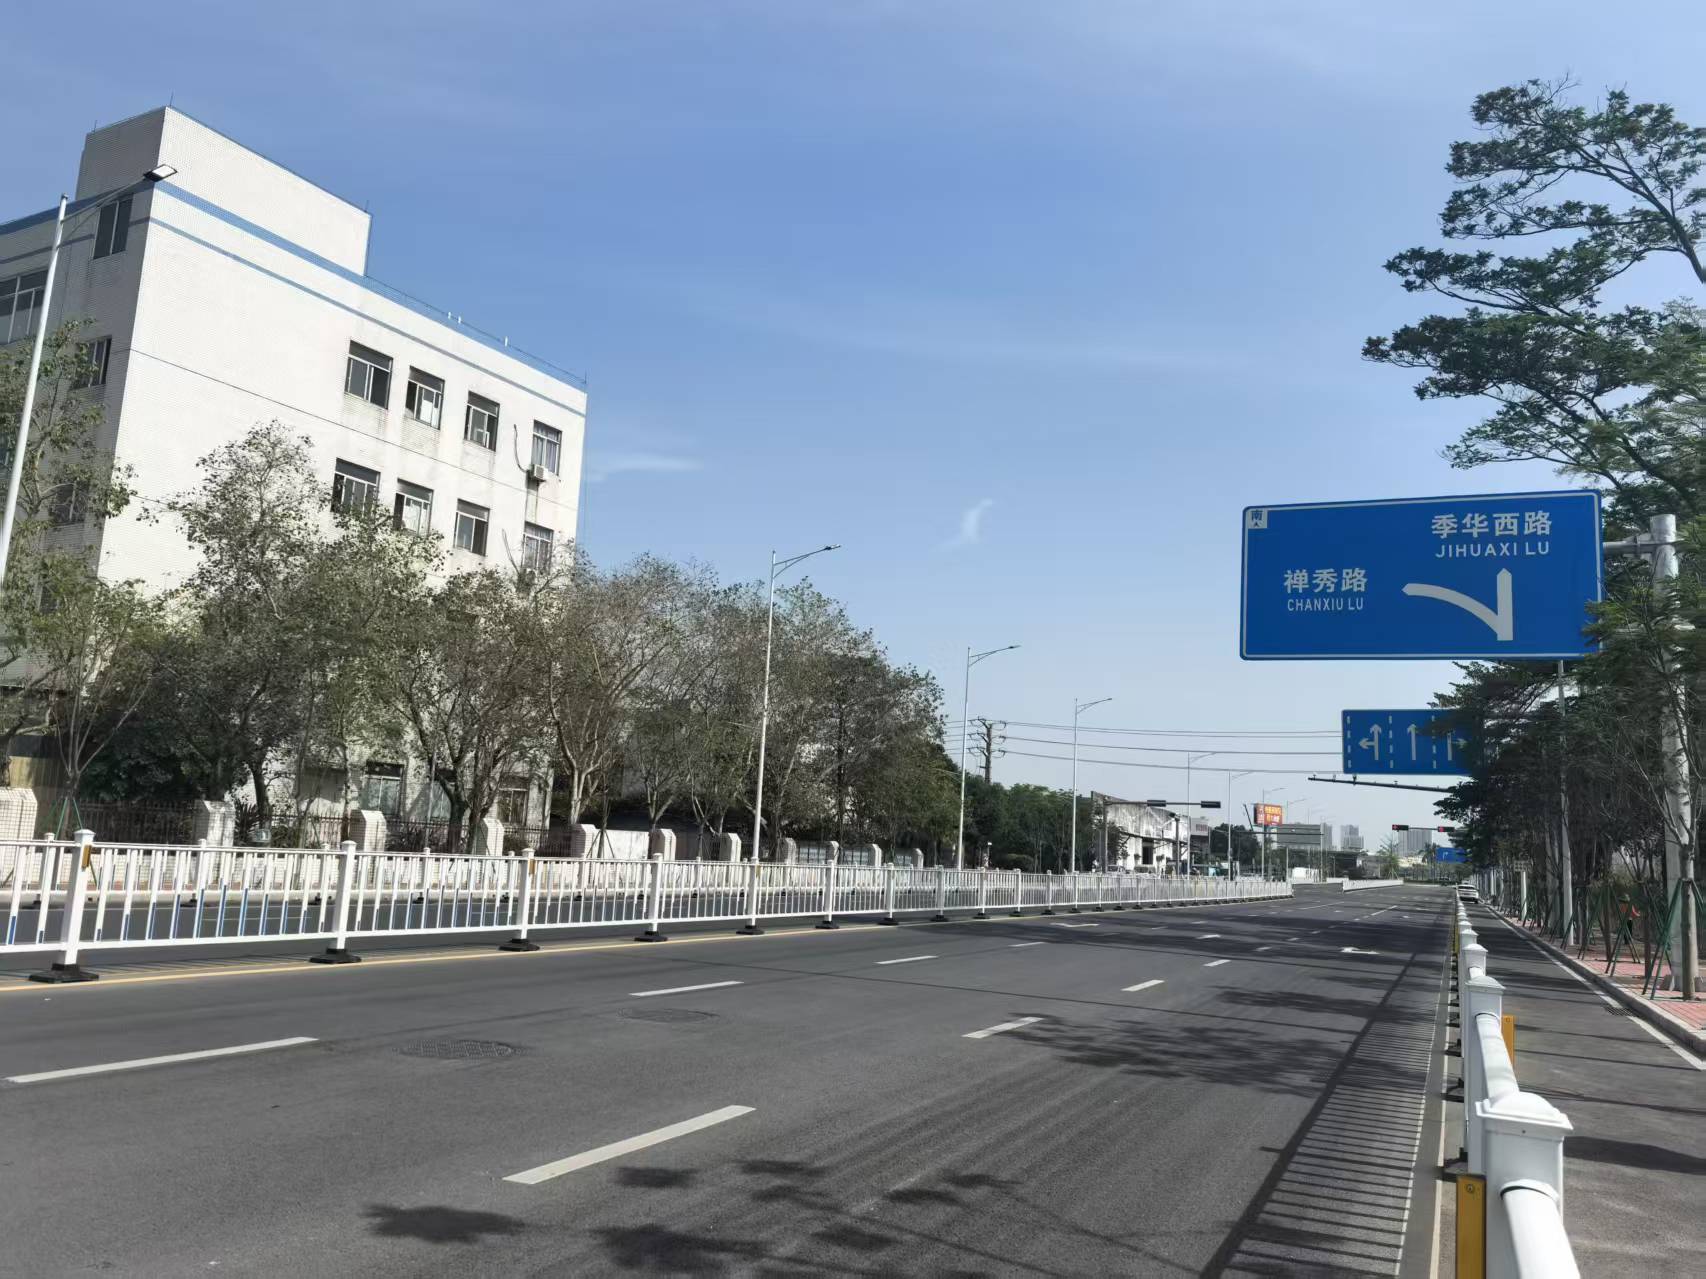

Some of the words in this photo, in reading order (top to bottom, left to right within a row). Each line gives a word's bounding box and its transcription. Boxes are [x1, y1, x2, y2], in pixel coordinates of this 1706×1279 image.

[1431, 510, 1552, 539] 季华西路
[1435, 542, 1517, 558] JIHUAXI
[1525, 541, 1549, 556] LU
[1283, 567, 1368, 594] 禅秀路
[1287, 598, 1344, 612] CHANXIU
[1348, 597, 1364, 611] LU
